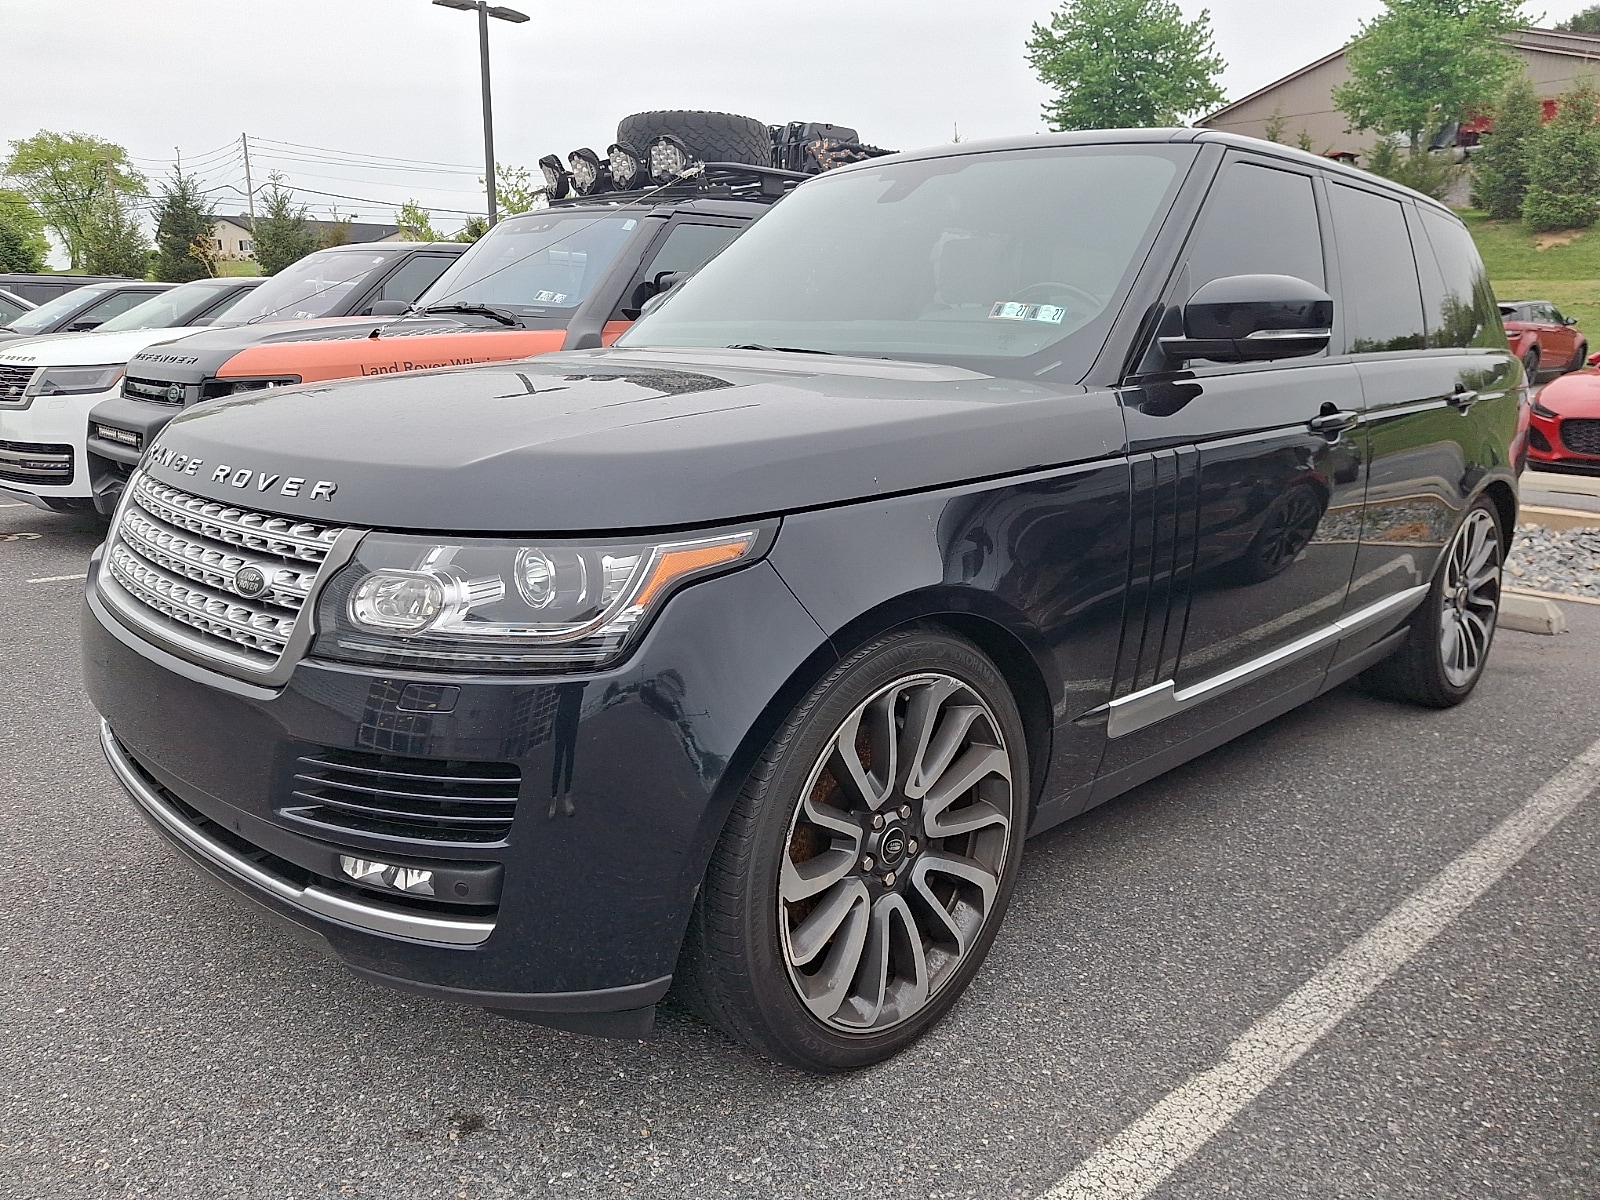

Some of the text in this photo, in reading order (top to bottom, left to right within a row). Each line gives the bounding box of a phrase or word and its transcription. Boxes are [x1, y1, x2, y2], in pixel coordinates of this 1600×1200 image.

[1015, 304, 1028, 317] 27
[1051, 308, 1064, 321] 27
[360, 361, 399, 377] Land
[149, 443, 339, 502] RANGE ROVER
